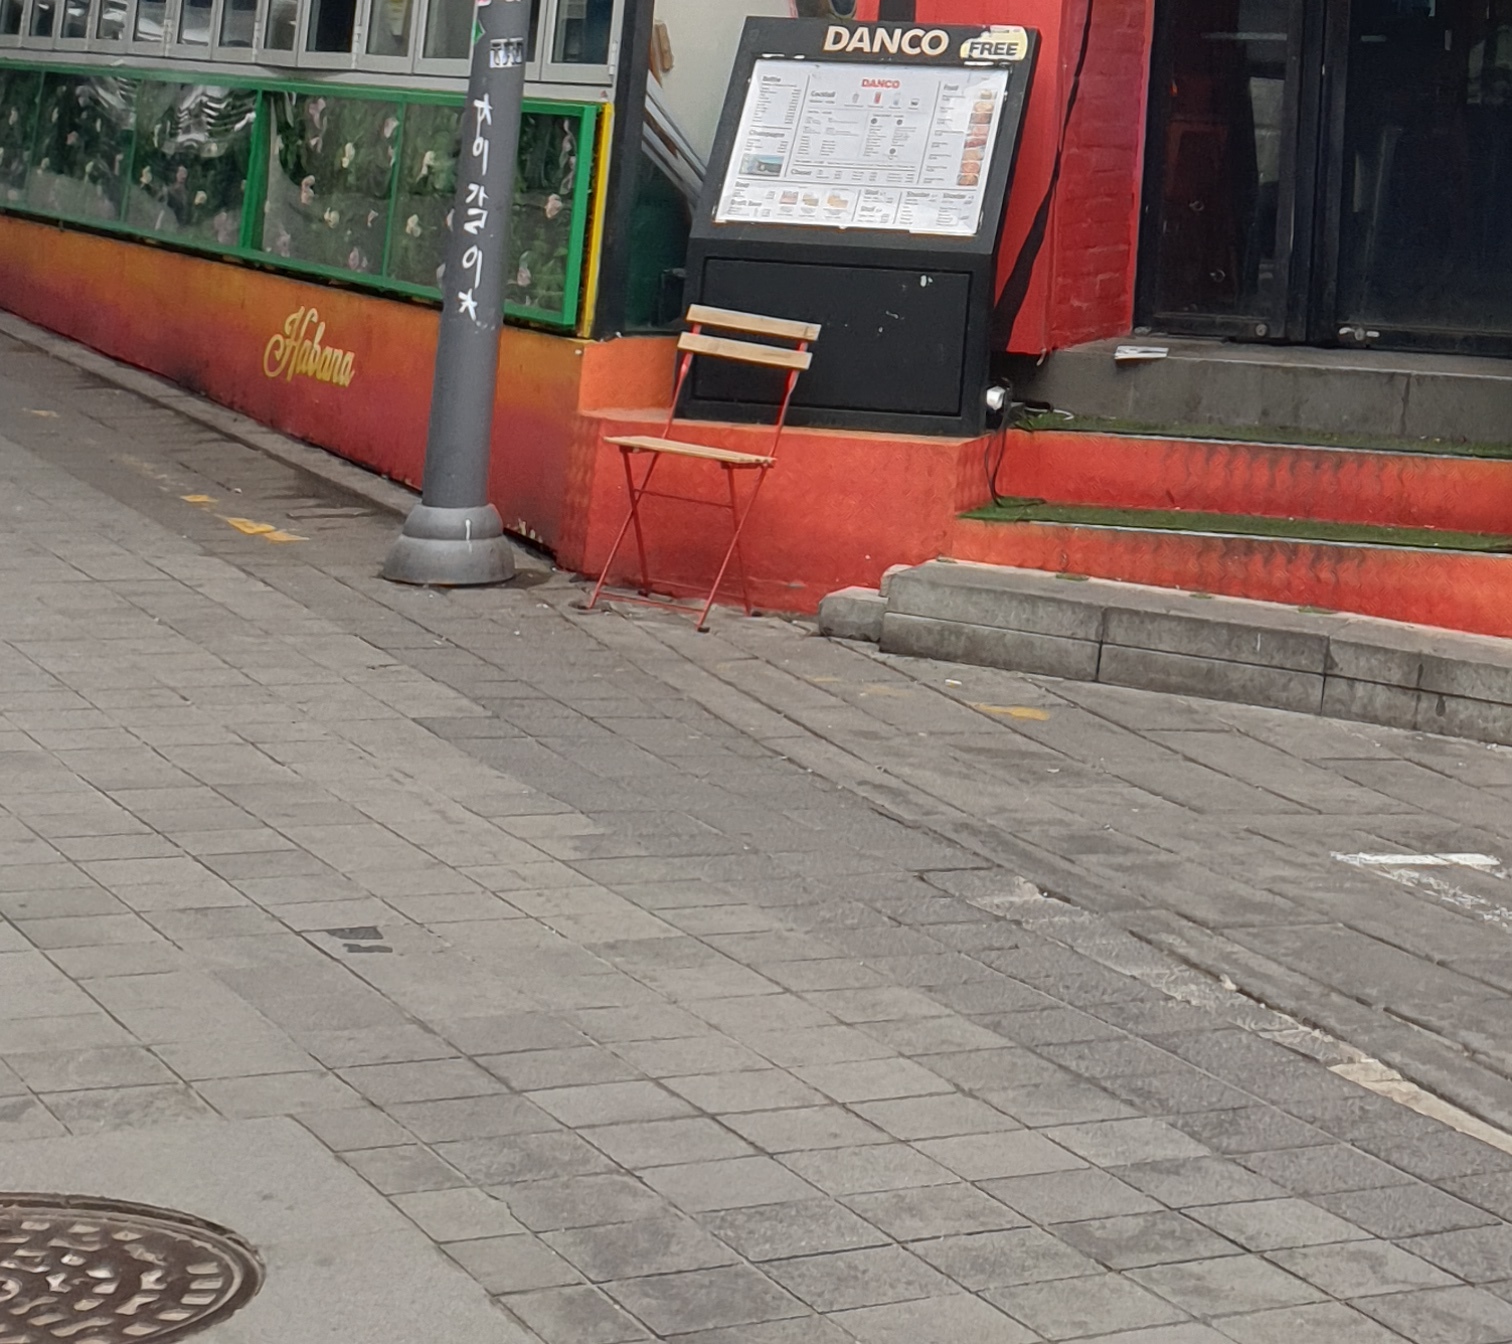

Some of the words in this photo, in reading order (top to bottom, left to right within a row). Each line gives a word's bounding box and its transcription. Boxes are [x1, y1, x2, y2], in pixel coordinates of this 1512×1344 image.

[822, 24, 950, 57] DANCO
[967, 41, 1020, 57] FREE
[861, 78, 901, 89] DANCO
[263, 305, 356, 388] Habana
